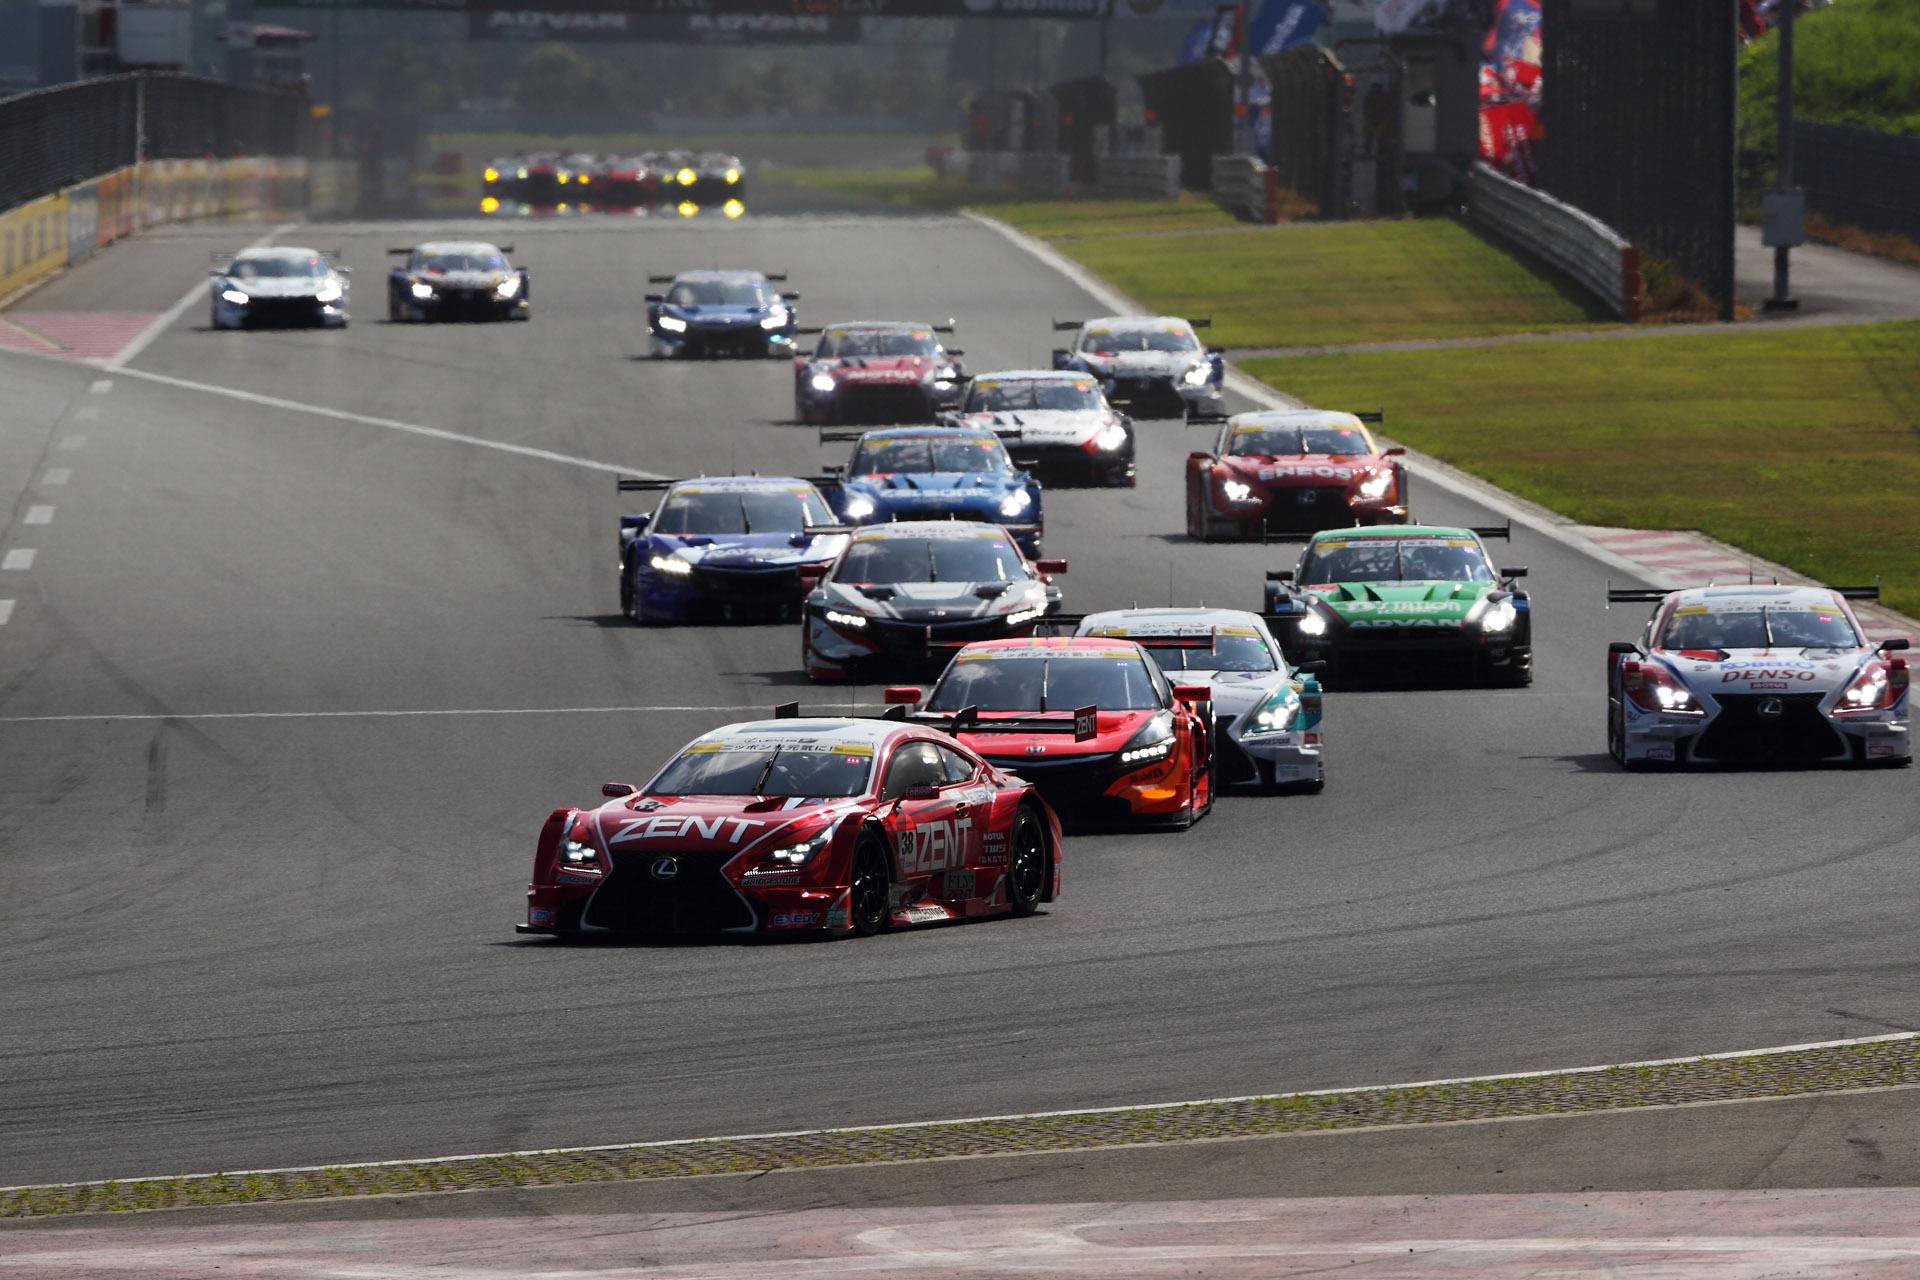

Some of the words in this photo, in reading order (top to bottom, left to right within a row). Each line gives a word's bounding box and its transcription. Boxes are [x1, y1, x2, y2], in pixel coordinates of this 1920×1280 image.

[486, 11, 628, 31] ADVAN
[688, 13, 830, 33] ADVAN
[1258, 466, 1352, 481] ENEOS
[1350, 619, 1463, 629] ADVAN
[1721, 669, 1817, 683] DENSO
[1752, 682, 1787, 690] MOTUL
[1075, 713, 1097, 736] ZENT
[609, 815, 767, 845] ZENT
[983, 832, 1005, 842] MOTUL
[901, 831, 914, 856] 38
[915, 817, 973, 873] ZENT
[978, 855, 1008, 865] TAKATA
[743, 876, 800, 886] BRIDGESTONE
[773, 913, 820, 926] EXEDY
